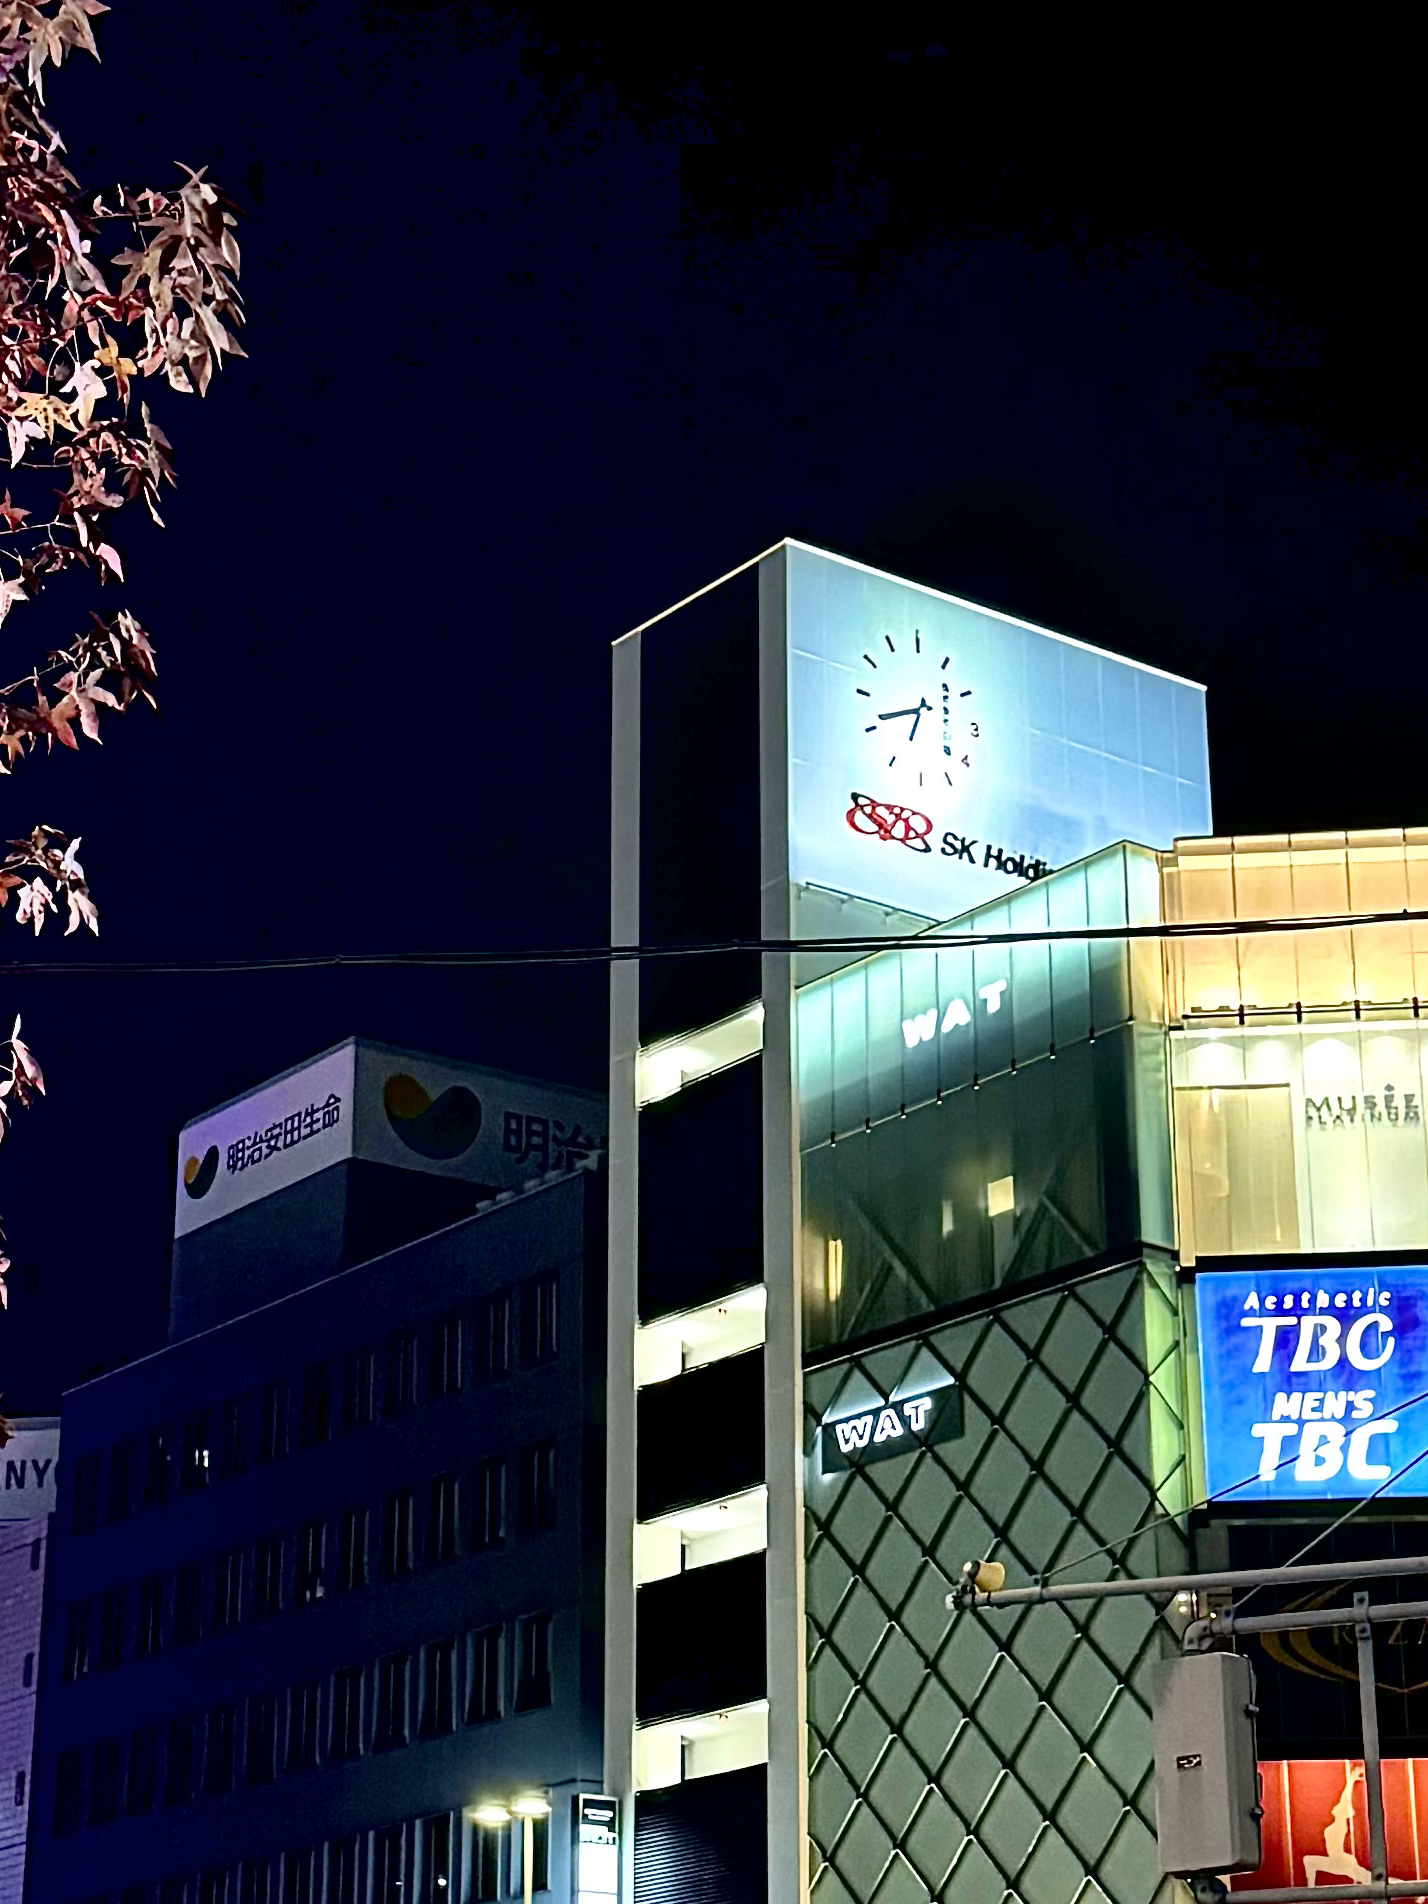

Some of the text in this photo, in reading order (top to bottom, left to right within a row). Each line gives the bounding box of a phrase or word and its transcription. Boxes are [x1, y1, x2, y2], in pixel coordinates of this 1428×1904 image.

[940, 832, 978, 864] SK
[902, 978, 1008, 1049] WAT
[226, 1093, 342, 1175] 明治安田生命
[1243, 1287, 1392, 1310] Aesthetic
[1240, 1312, 1396, 1374] TBC
[835, 1396, 932, 1453] WAT
[1271, 1389, 1377, 1421] MEN'S
[1250, 1418, 1400, 1482] TBC
